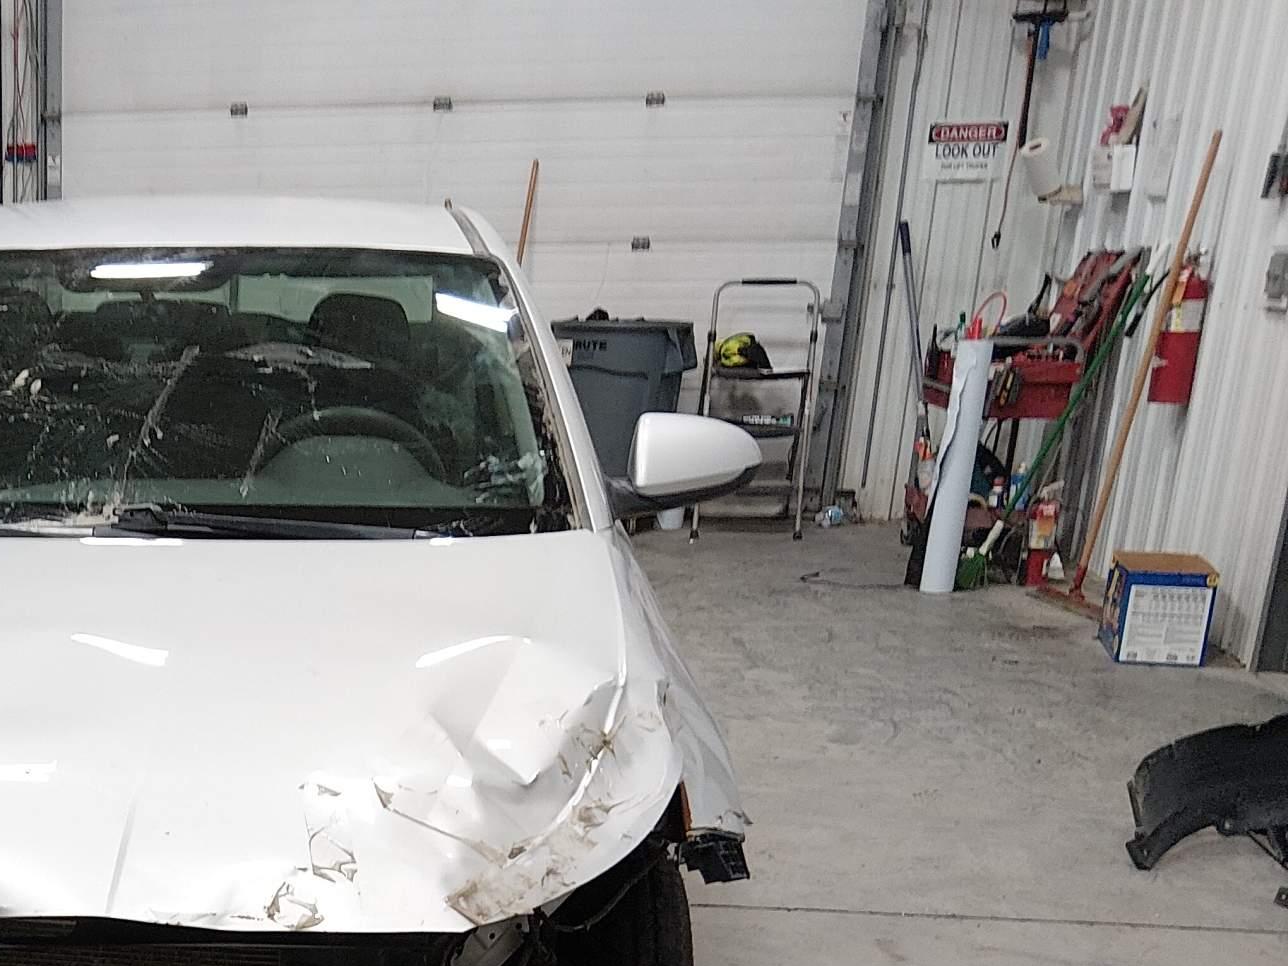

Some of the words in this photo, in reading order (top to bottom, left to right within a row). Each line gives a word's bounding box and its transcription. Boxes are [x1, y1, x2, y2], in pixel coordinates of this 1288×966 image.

[940, 126, 997, 140] DANGER
[935, 143, 969, 159] LOOK
[972, 143, 998, 159] OUT
